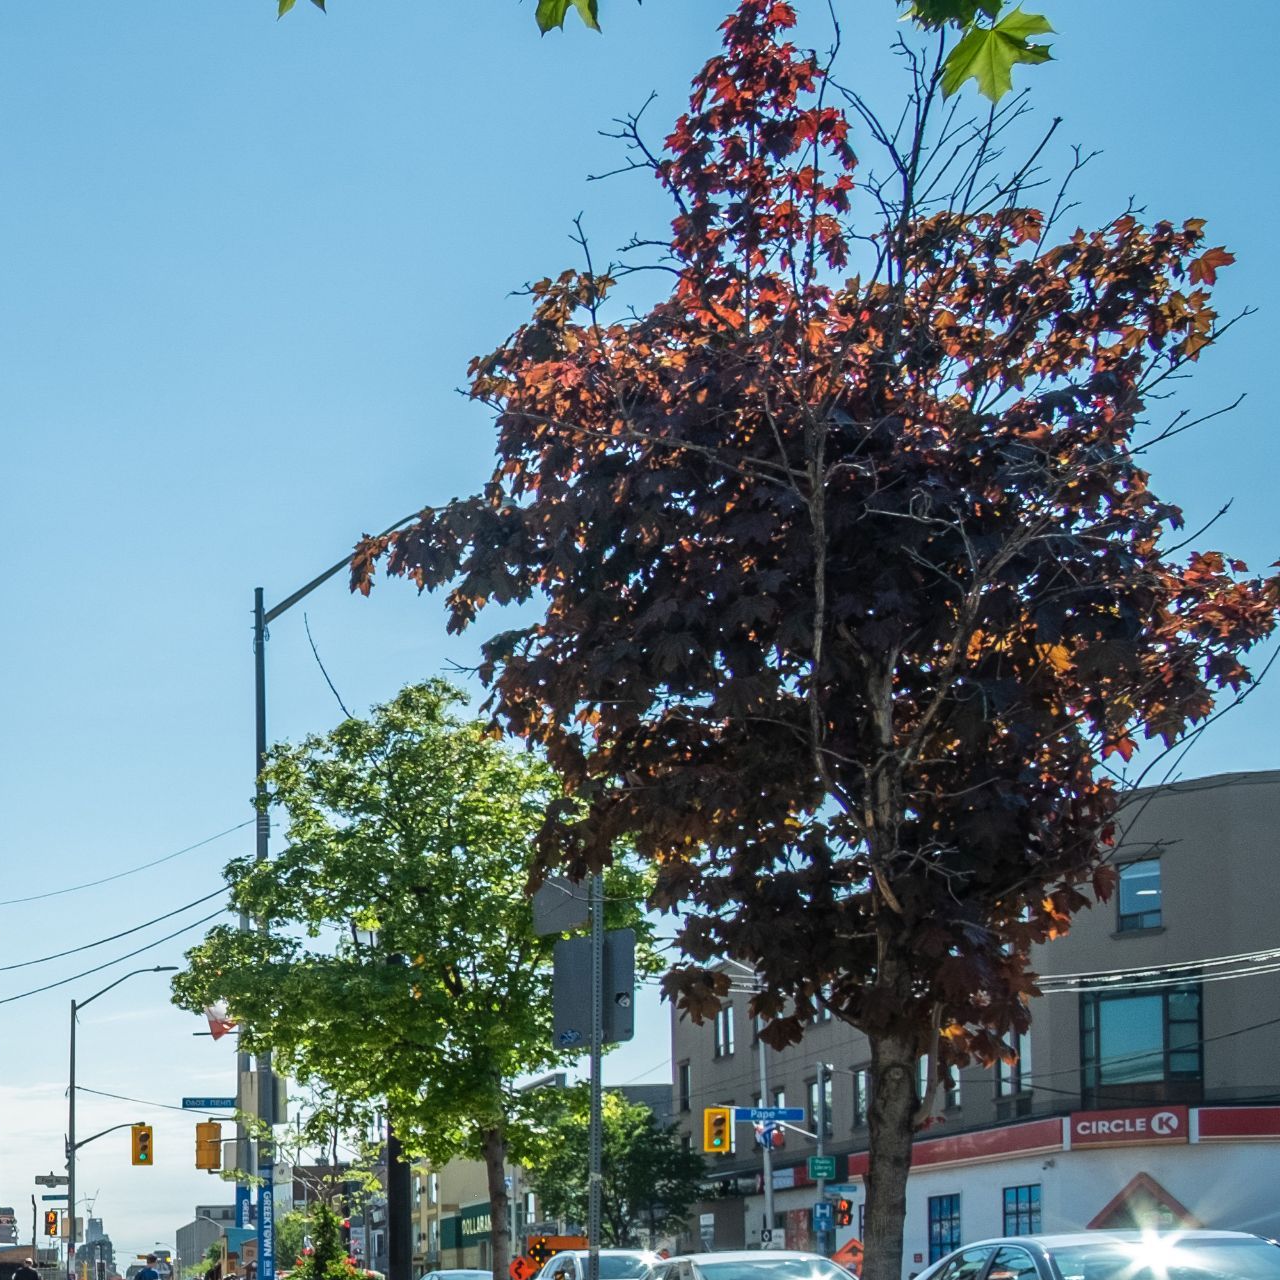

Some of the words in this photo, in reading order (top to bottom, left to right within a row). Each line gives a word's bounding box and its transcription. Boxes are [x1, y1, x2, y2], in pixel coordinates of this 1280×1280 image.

[751, 1110, 775, 1119] Pape
[1077, 1118, 1146, 1135] CIRCLE
[815, 1205, 831, 1218] H
[263, 1190, 272, 1257] GREEKTOWN
